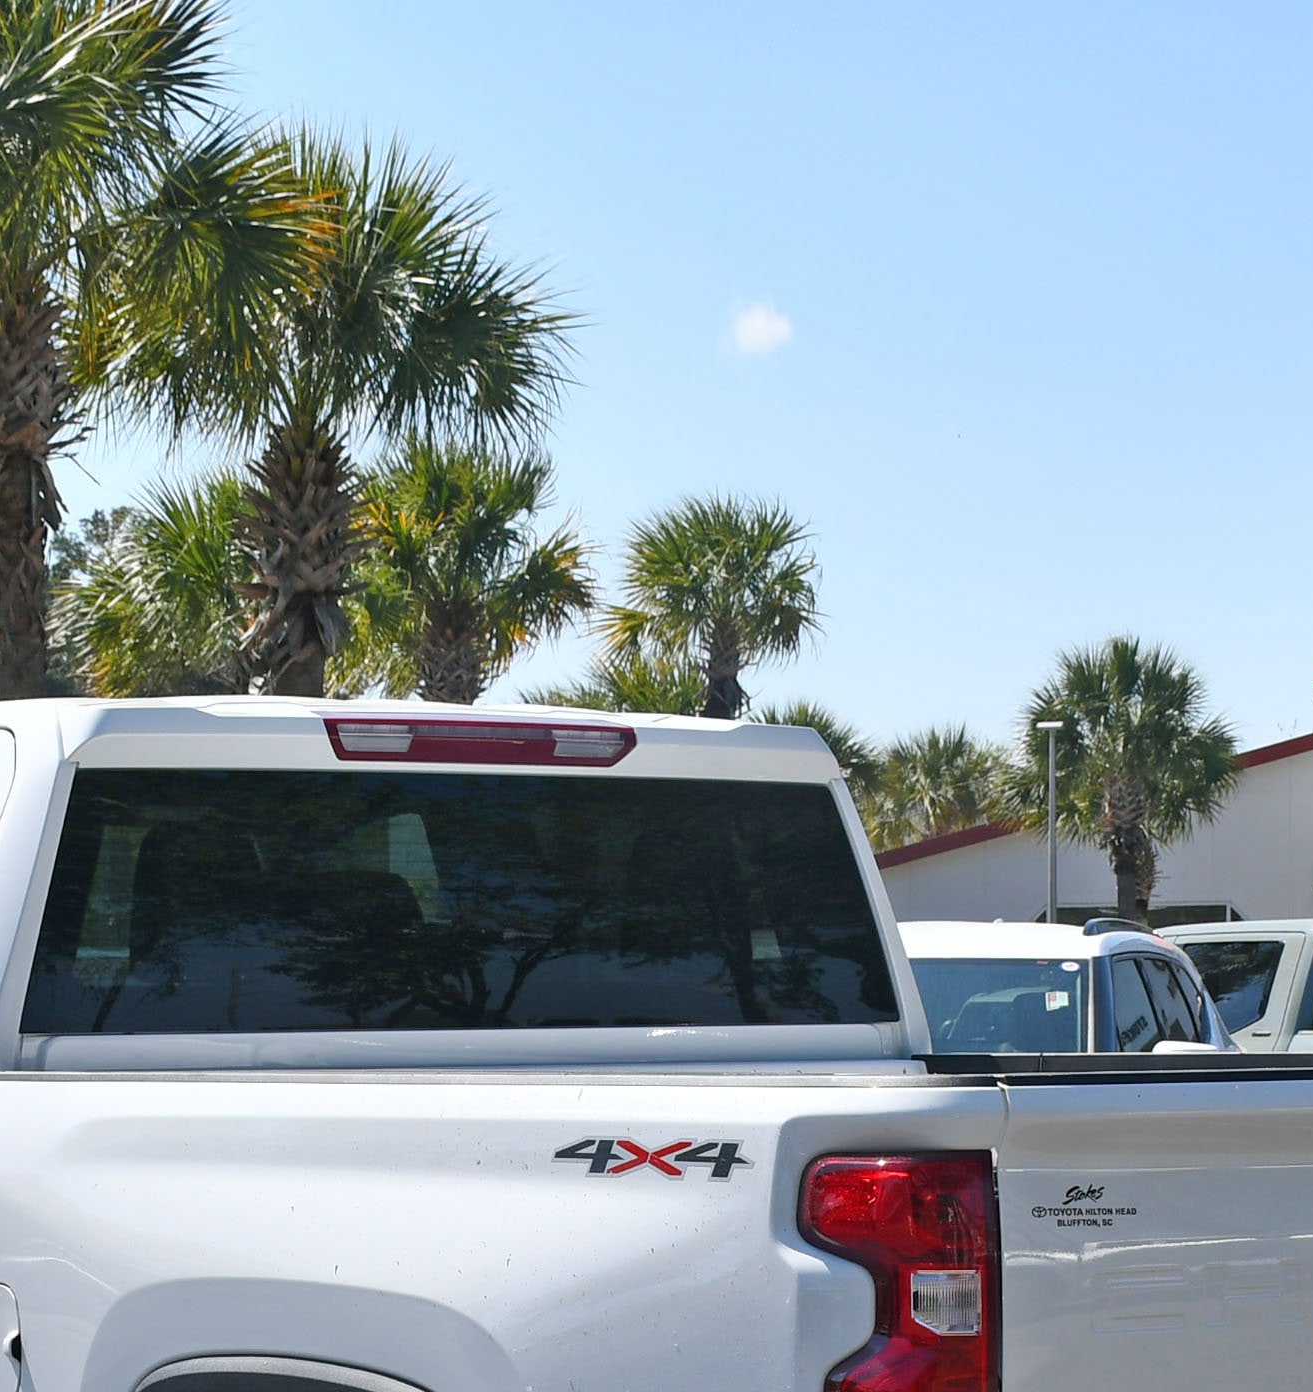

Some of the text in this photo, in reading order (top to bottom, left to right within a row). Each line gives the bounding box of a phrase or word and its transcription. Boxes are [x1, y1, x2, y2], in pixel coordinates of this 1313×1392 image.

[1062, 1184, 1105, 1205] Stokes
[1048, 1207, 1137, 1216] TOYOTA HILTON HEAD
[1057, 1218, 1113, 1228] BLUFFTON, SC
